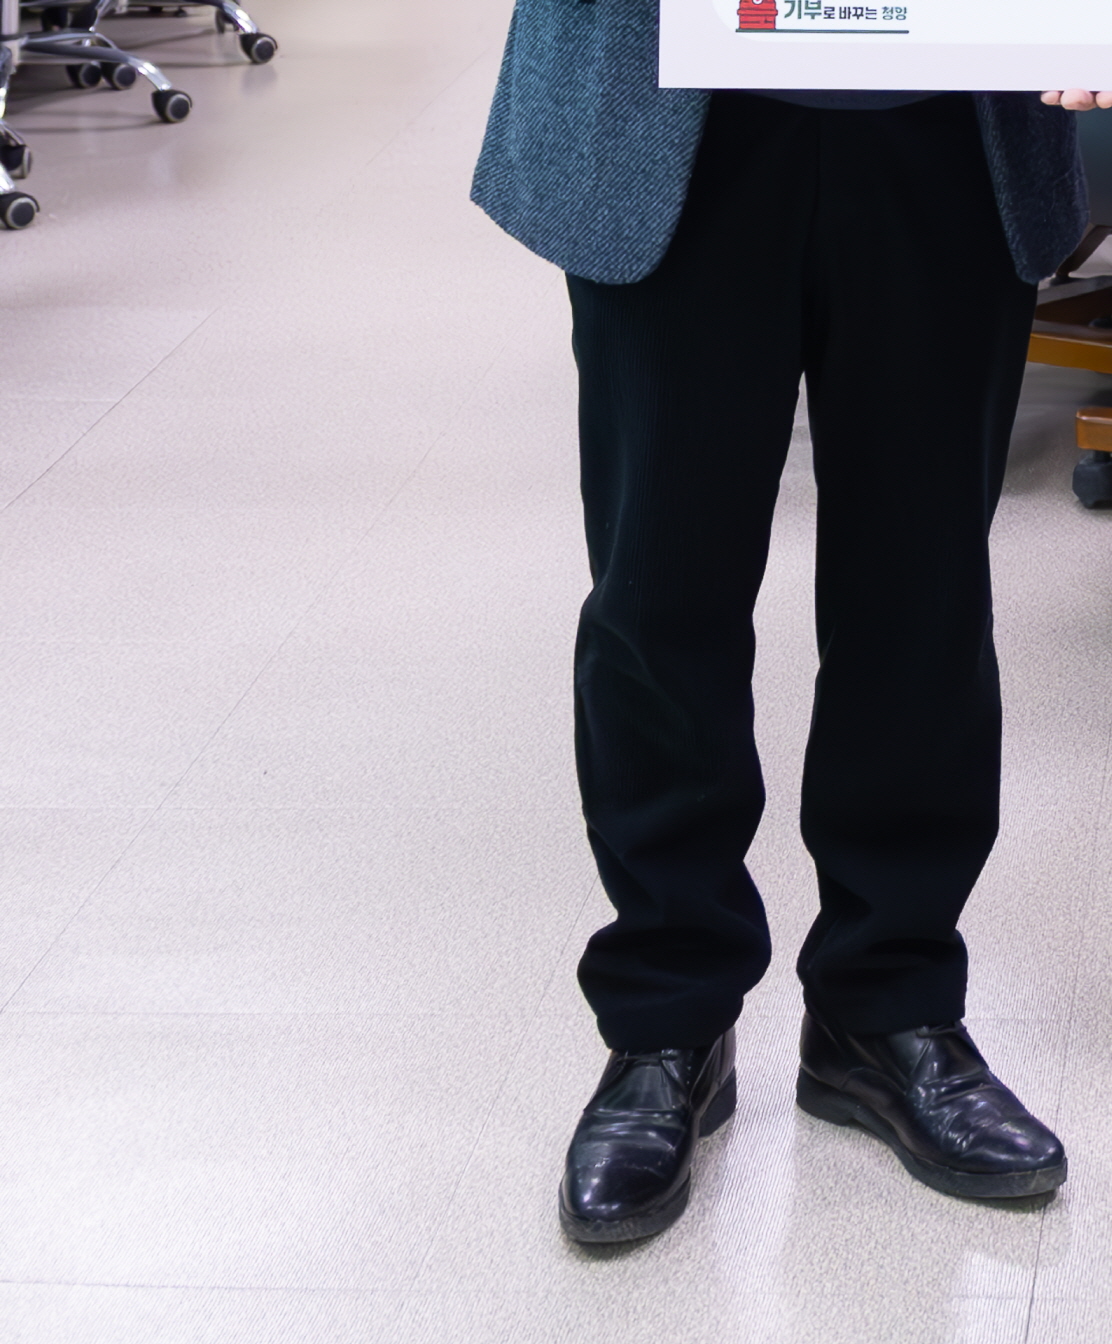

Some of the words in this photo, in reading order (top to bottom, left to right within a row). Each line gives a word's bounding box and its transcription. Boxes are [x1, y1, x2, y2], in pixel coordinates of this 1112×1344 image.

[783, 0, 836, 20] 기부로
[839, 6, 878, 21] 바꾸는
[881, 6, 908, 21] 청양
